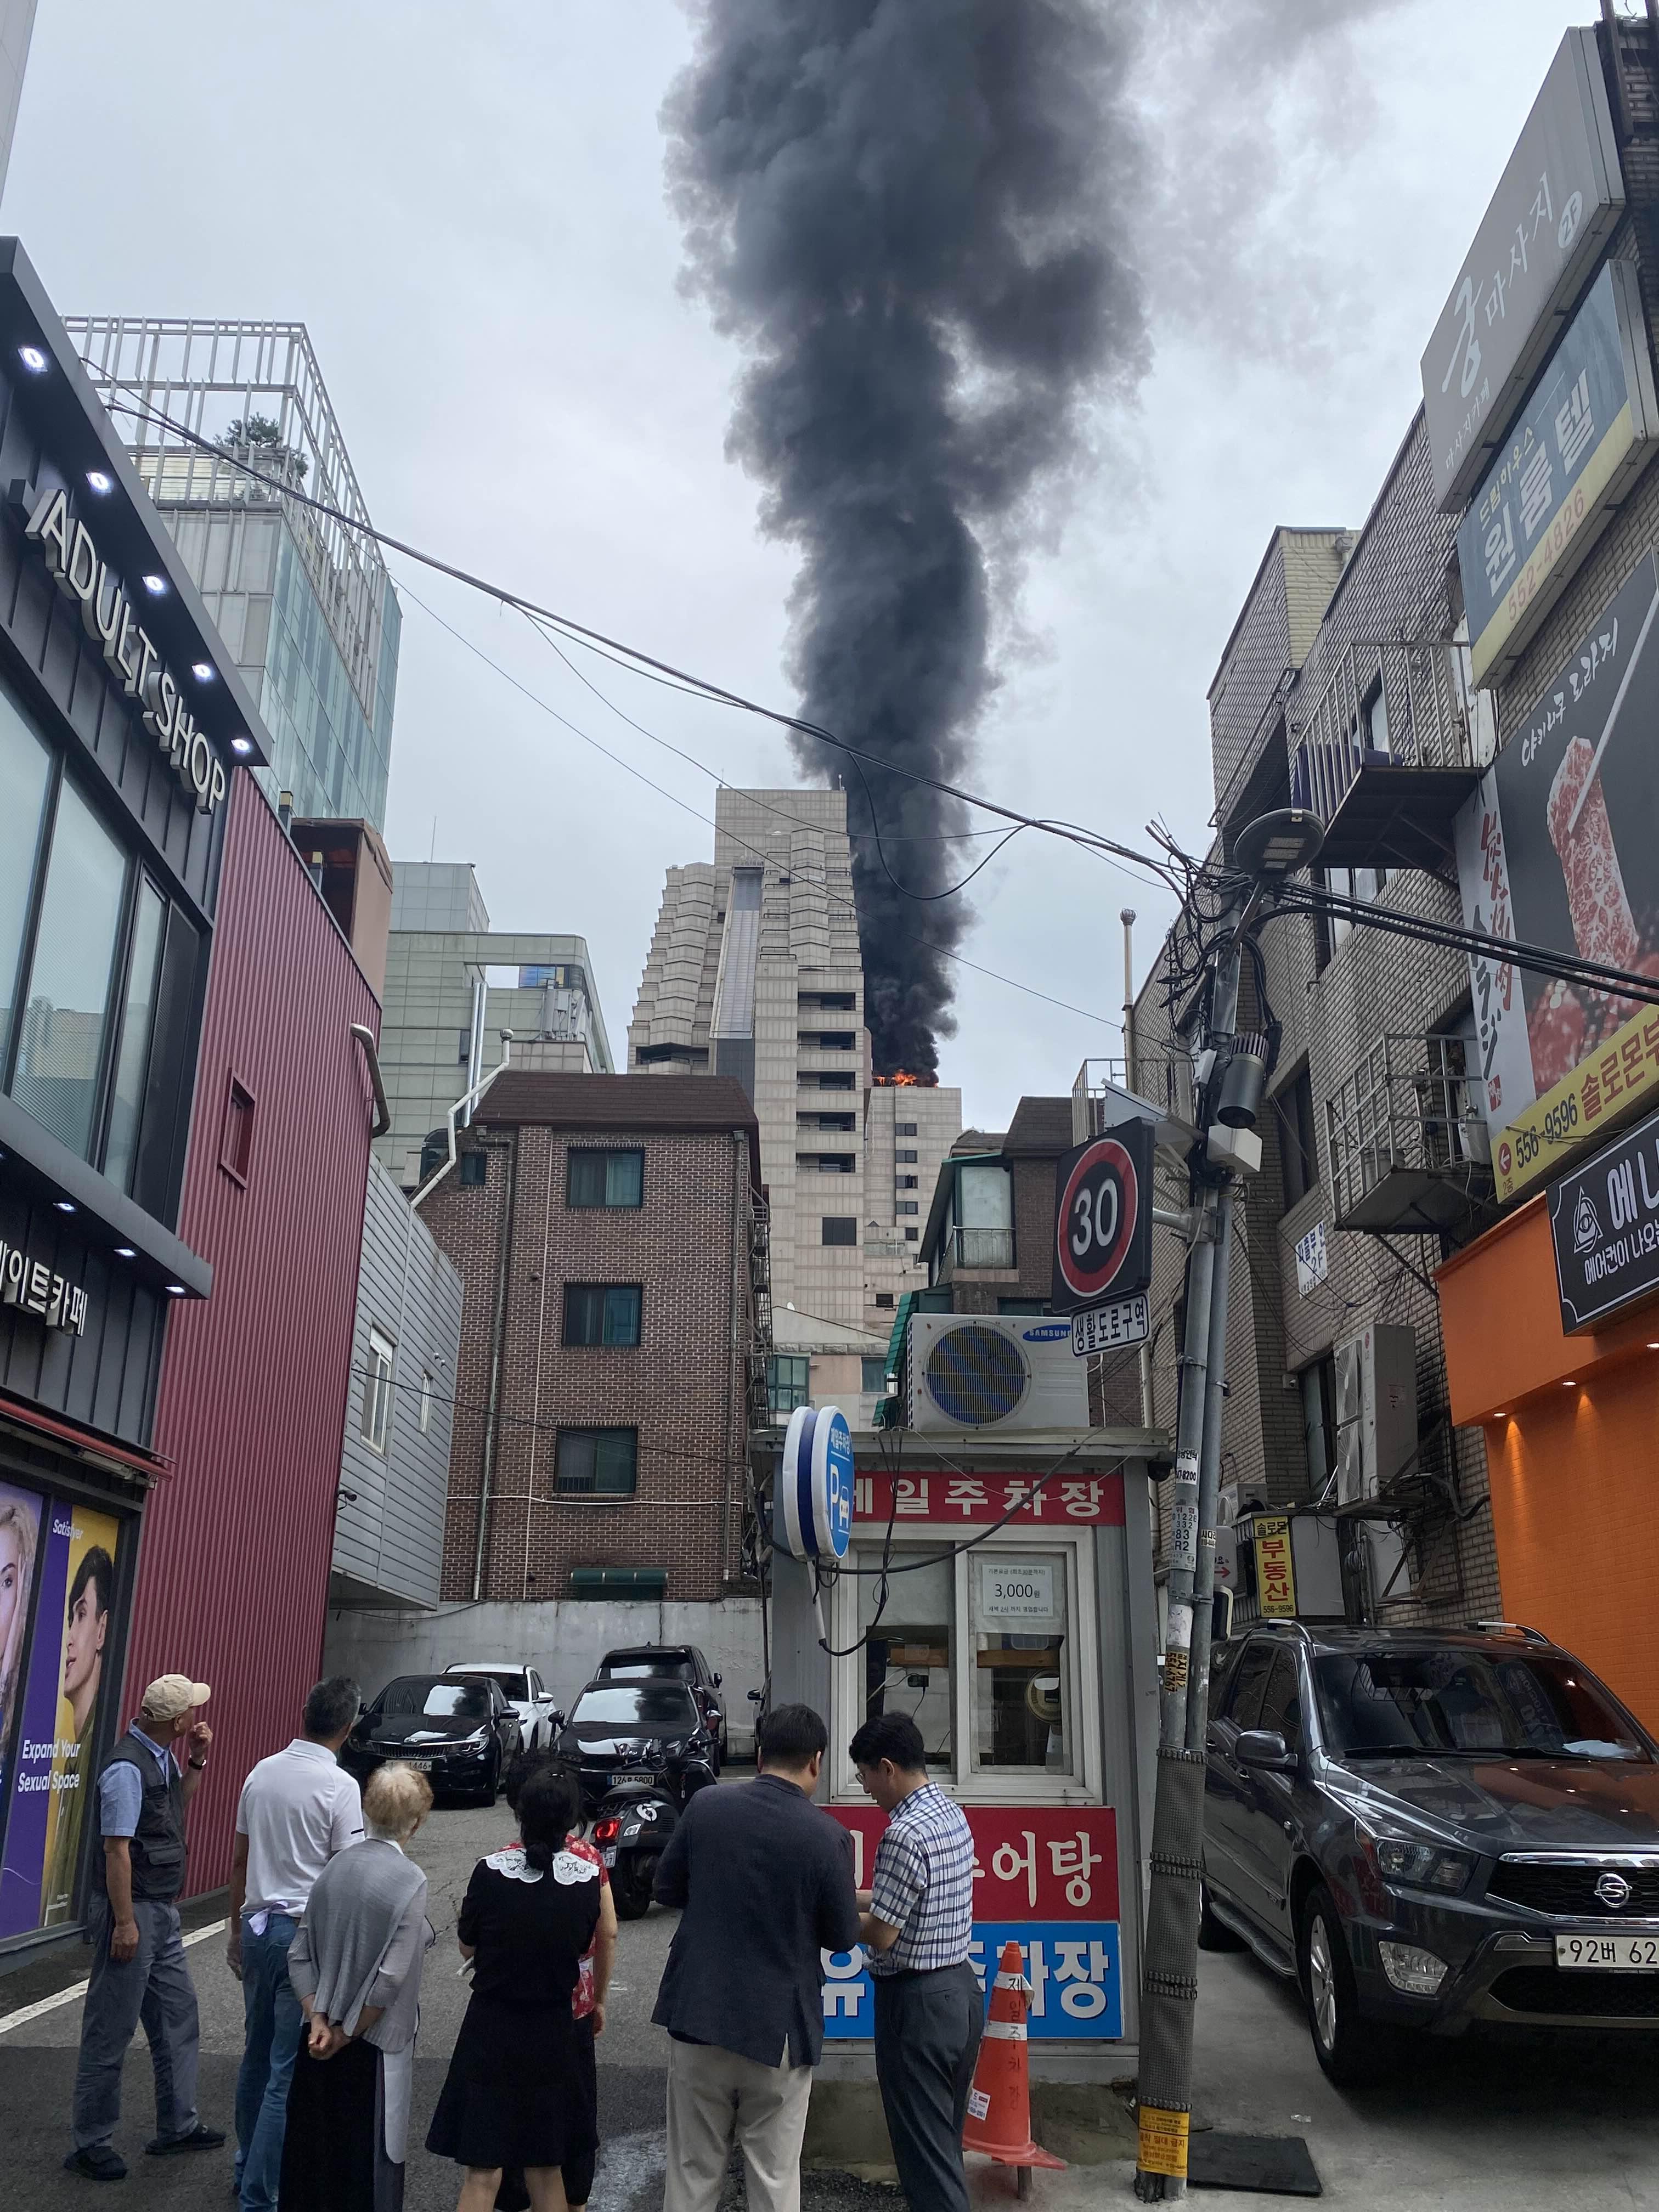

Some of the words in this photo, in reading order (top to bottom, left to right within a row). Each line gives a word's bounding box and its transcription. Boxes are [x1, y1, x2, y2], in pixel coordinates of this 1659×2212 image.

[1485, 171, 1554, 327] 마사지
[1444, 376, 1491, 471] 마사지카페
[1479, 426, 1537, 531] 드림하우스
[1483, 367, 1595, 598] 원룸텔
[1506, 488, 1585, 622] 552-4826
[40, 489, 159, 697] ADULT
[151, 672, 225, 813] SHOP
[1569, 617, 1618, 703] 도라지
[1515, 1092, 1579, 1169] 556-9596
[1072, 1178, 1118, 1256] 30
[1502, 1176, 1514, 1197] 2층
[1584, 1237, 1630, 1285] 에어컨이
[1630, 1218, 1659, 1259] 나오
[1075, 1299, 1146, 1351] 생활도로구역
[830, 1463, 839, 1530] P
[1176, 1521, 1193, 1530] 332
[1256, 1521, 1287, 1536] 솔로몬
[1175, 1530, 1190, 1540] 83
[1175, 1541, 1189, 1551] R2
[995, 1583, 1041, 1599] 3,000원
[1261, 1539, 1290, 1602] 부동산
[1263, 1604, 1294, 1614] 556-9596
[18, 1770, 52, 1792] Sexual
[52, 1771, 80, 1795] Space
[22, 1737, 60, 1764] Expand
[61, 1739, 81, 1758] Your
[973, 1830, 1103, 1908] 어탕
[1570, 1939, 1616, 1962] 92버
